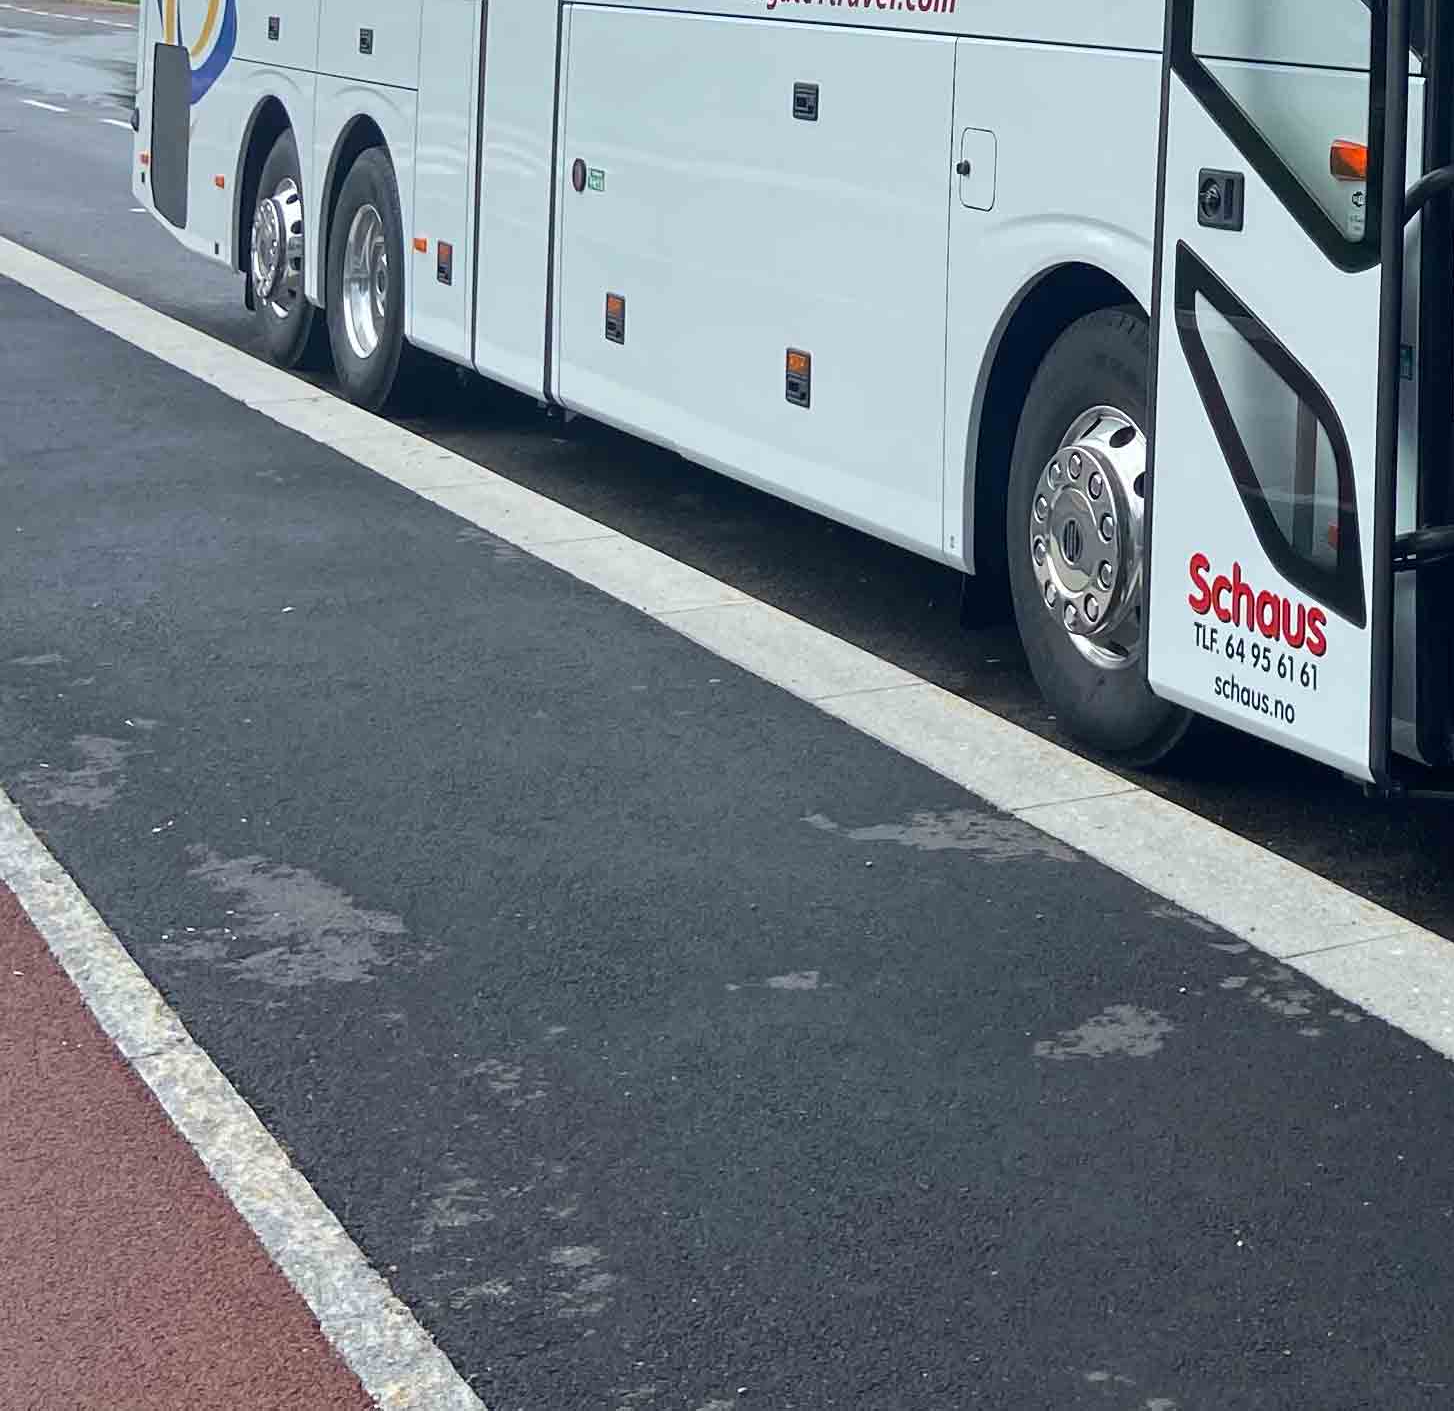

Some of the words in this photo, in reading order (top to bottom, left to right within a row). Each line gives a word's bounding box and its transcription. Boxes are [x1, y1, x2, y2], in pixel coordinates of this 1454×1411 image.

[1187, 551, 1328, 657] Schaus
[1193, 621, 1220, 655] TLF.
[1225, 634, 1246, 663] 64
[1251, 644, 1271, 673] 95
[1277, 653, 1295, 683] 61
[1300, 662, 1318, 691] 61
[1214, 673, 1296, 725] schaus.no
